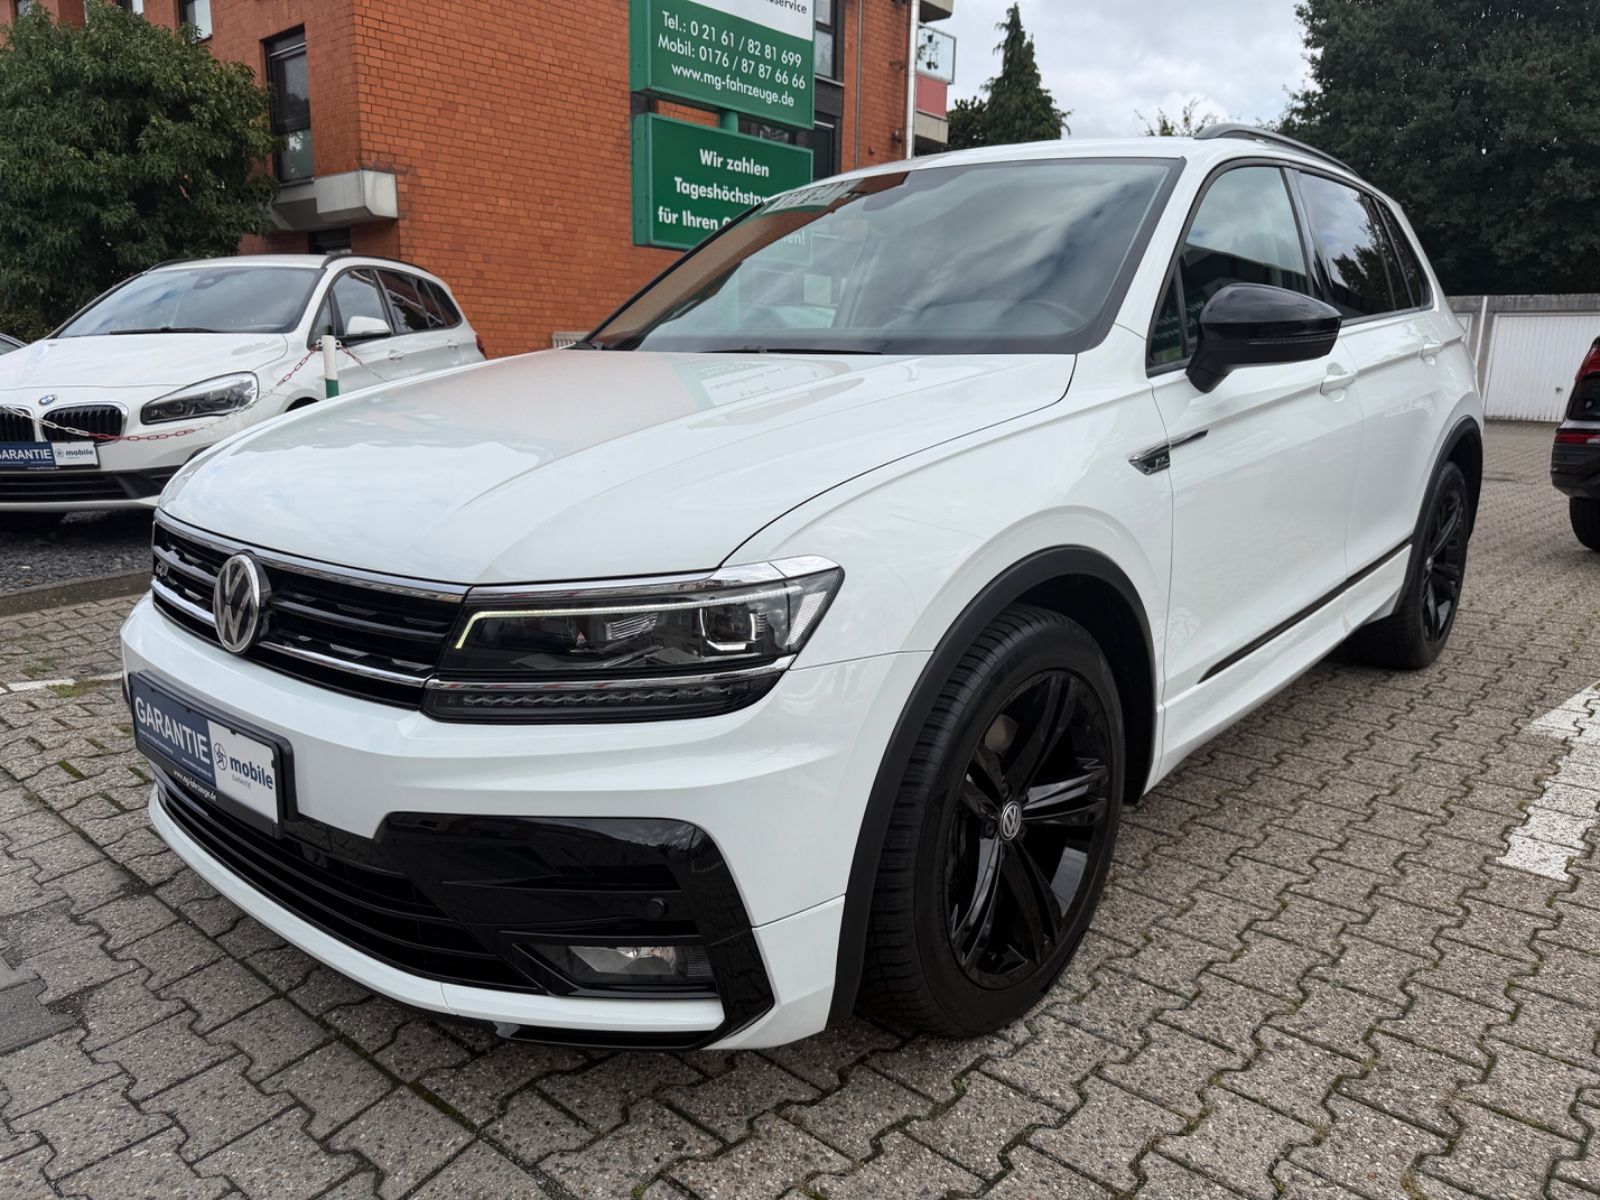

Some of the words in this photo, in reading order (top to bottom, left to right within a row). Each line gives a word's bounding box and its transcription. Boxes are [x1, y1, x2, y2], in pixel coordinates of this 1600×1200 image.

[766, 0, 807, 14] service
[662, 10, 686, 33] Tel.:
[690, 20, 699, 36] 0
[702, 24, 716, 42] 21
[721, 30, 734, 48] 61
[739, 36, 745, 51] /
[747, 38, 761, 56] 82
[764, 44, 777, 61] 81
[781, 49, 802, 68] 699
[658, 32, 695, 58] Mobil:
[699, 45, 729, 68] 0176
[732, 56, 738, 71] /
[741, 58, 755, 75] 87
[758, 63, 772, 80] 87
[775, 68, 789, 85] 66
[791, 73, 806, 90] 66
[671, 64, 794, 107] www.mg-fahrzeuge.de
[699, 148, 723, 168] Wir
[726, 157, 769, 178] zahlen
[658, 205, 679, 224] für
[682, 209, 718, 231] Ihren
[0, 448, 53, 460] ARANTIE
[66, 448, 94, 457] mobile
[134, 696, 211, 765] GARANTIE
[229, 756, 274, 790] mobile
